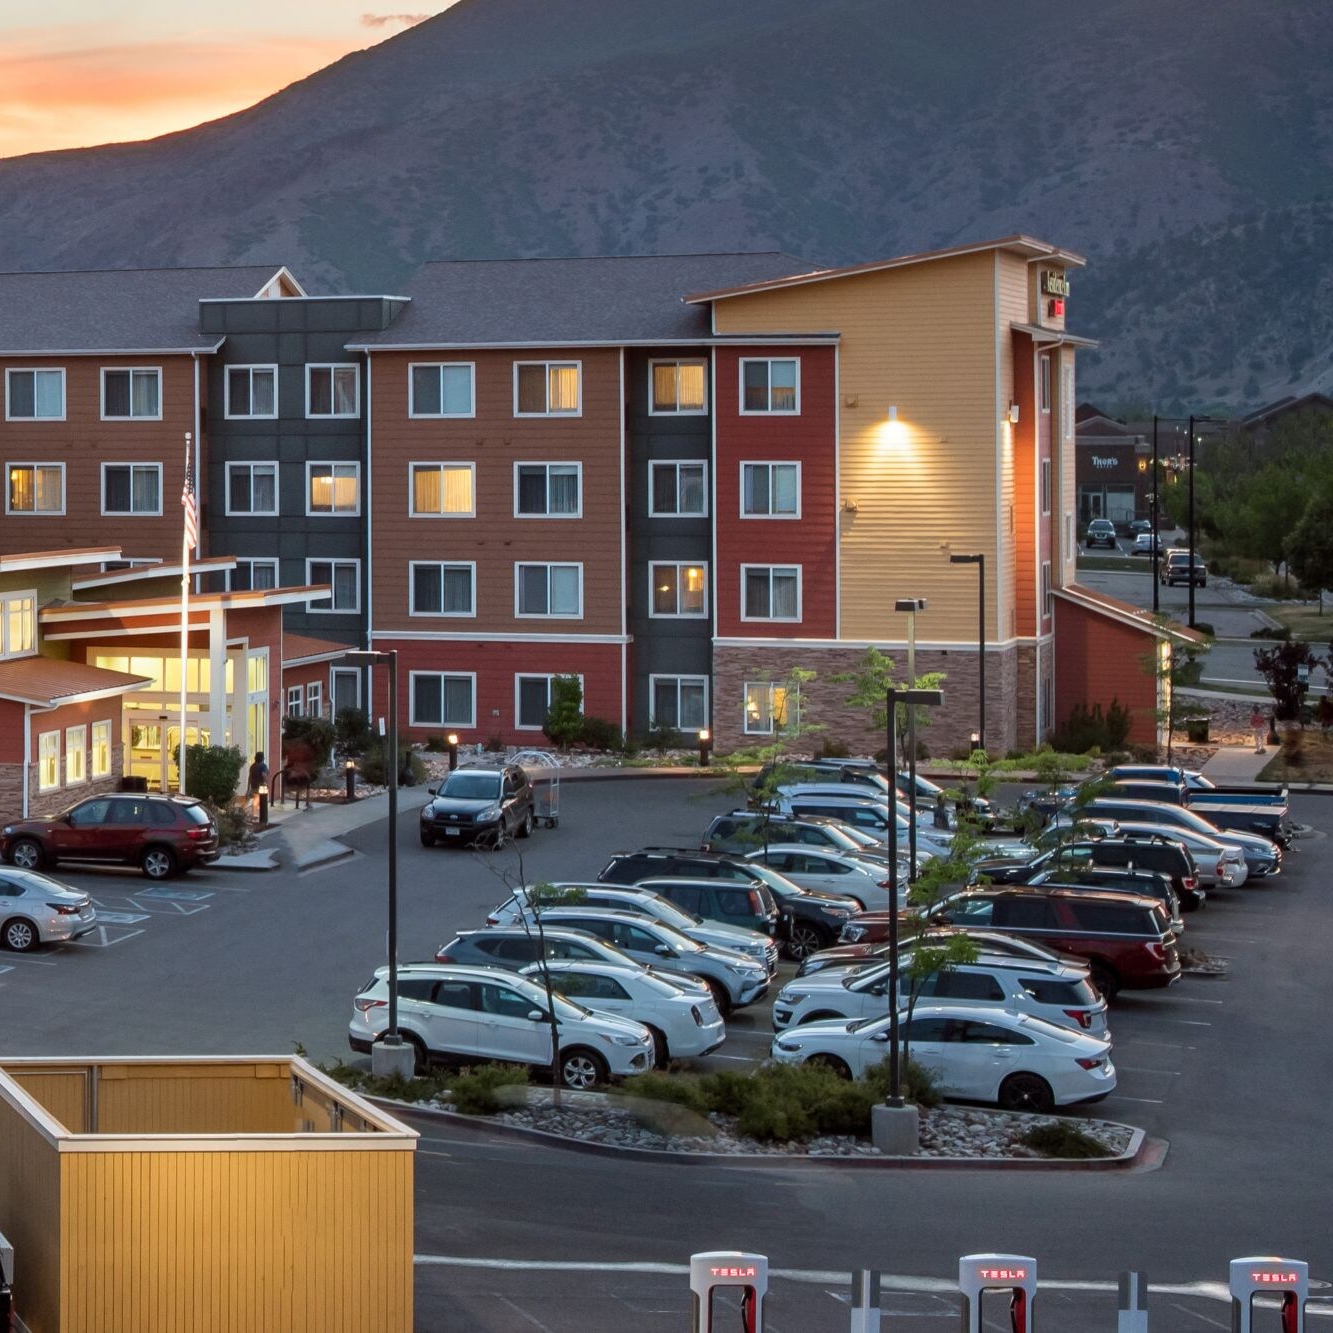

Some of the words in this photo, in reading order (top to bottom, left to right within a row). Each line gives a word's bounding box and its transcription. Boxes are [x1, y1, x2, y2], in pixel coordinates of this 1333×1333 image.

[710, 1268, 756, 1277] TESLA
[980, 1270, 1026, 1279] TESLA
[1252, 1273, 1297, 1282] TESLA
